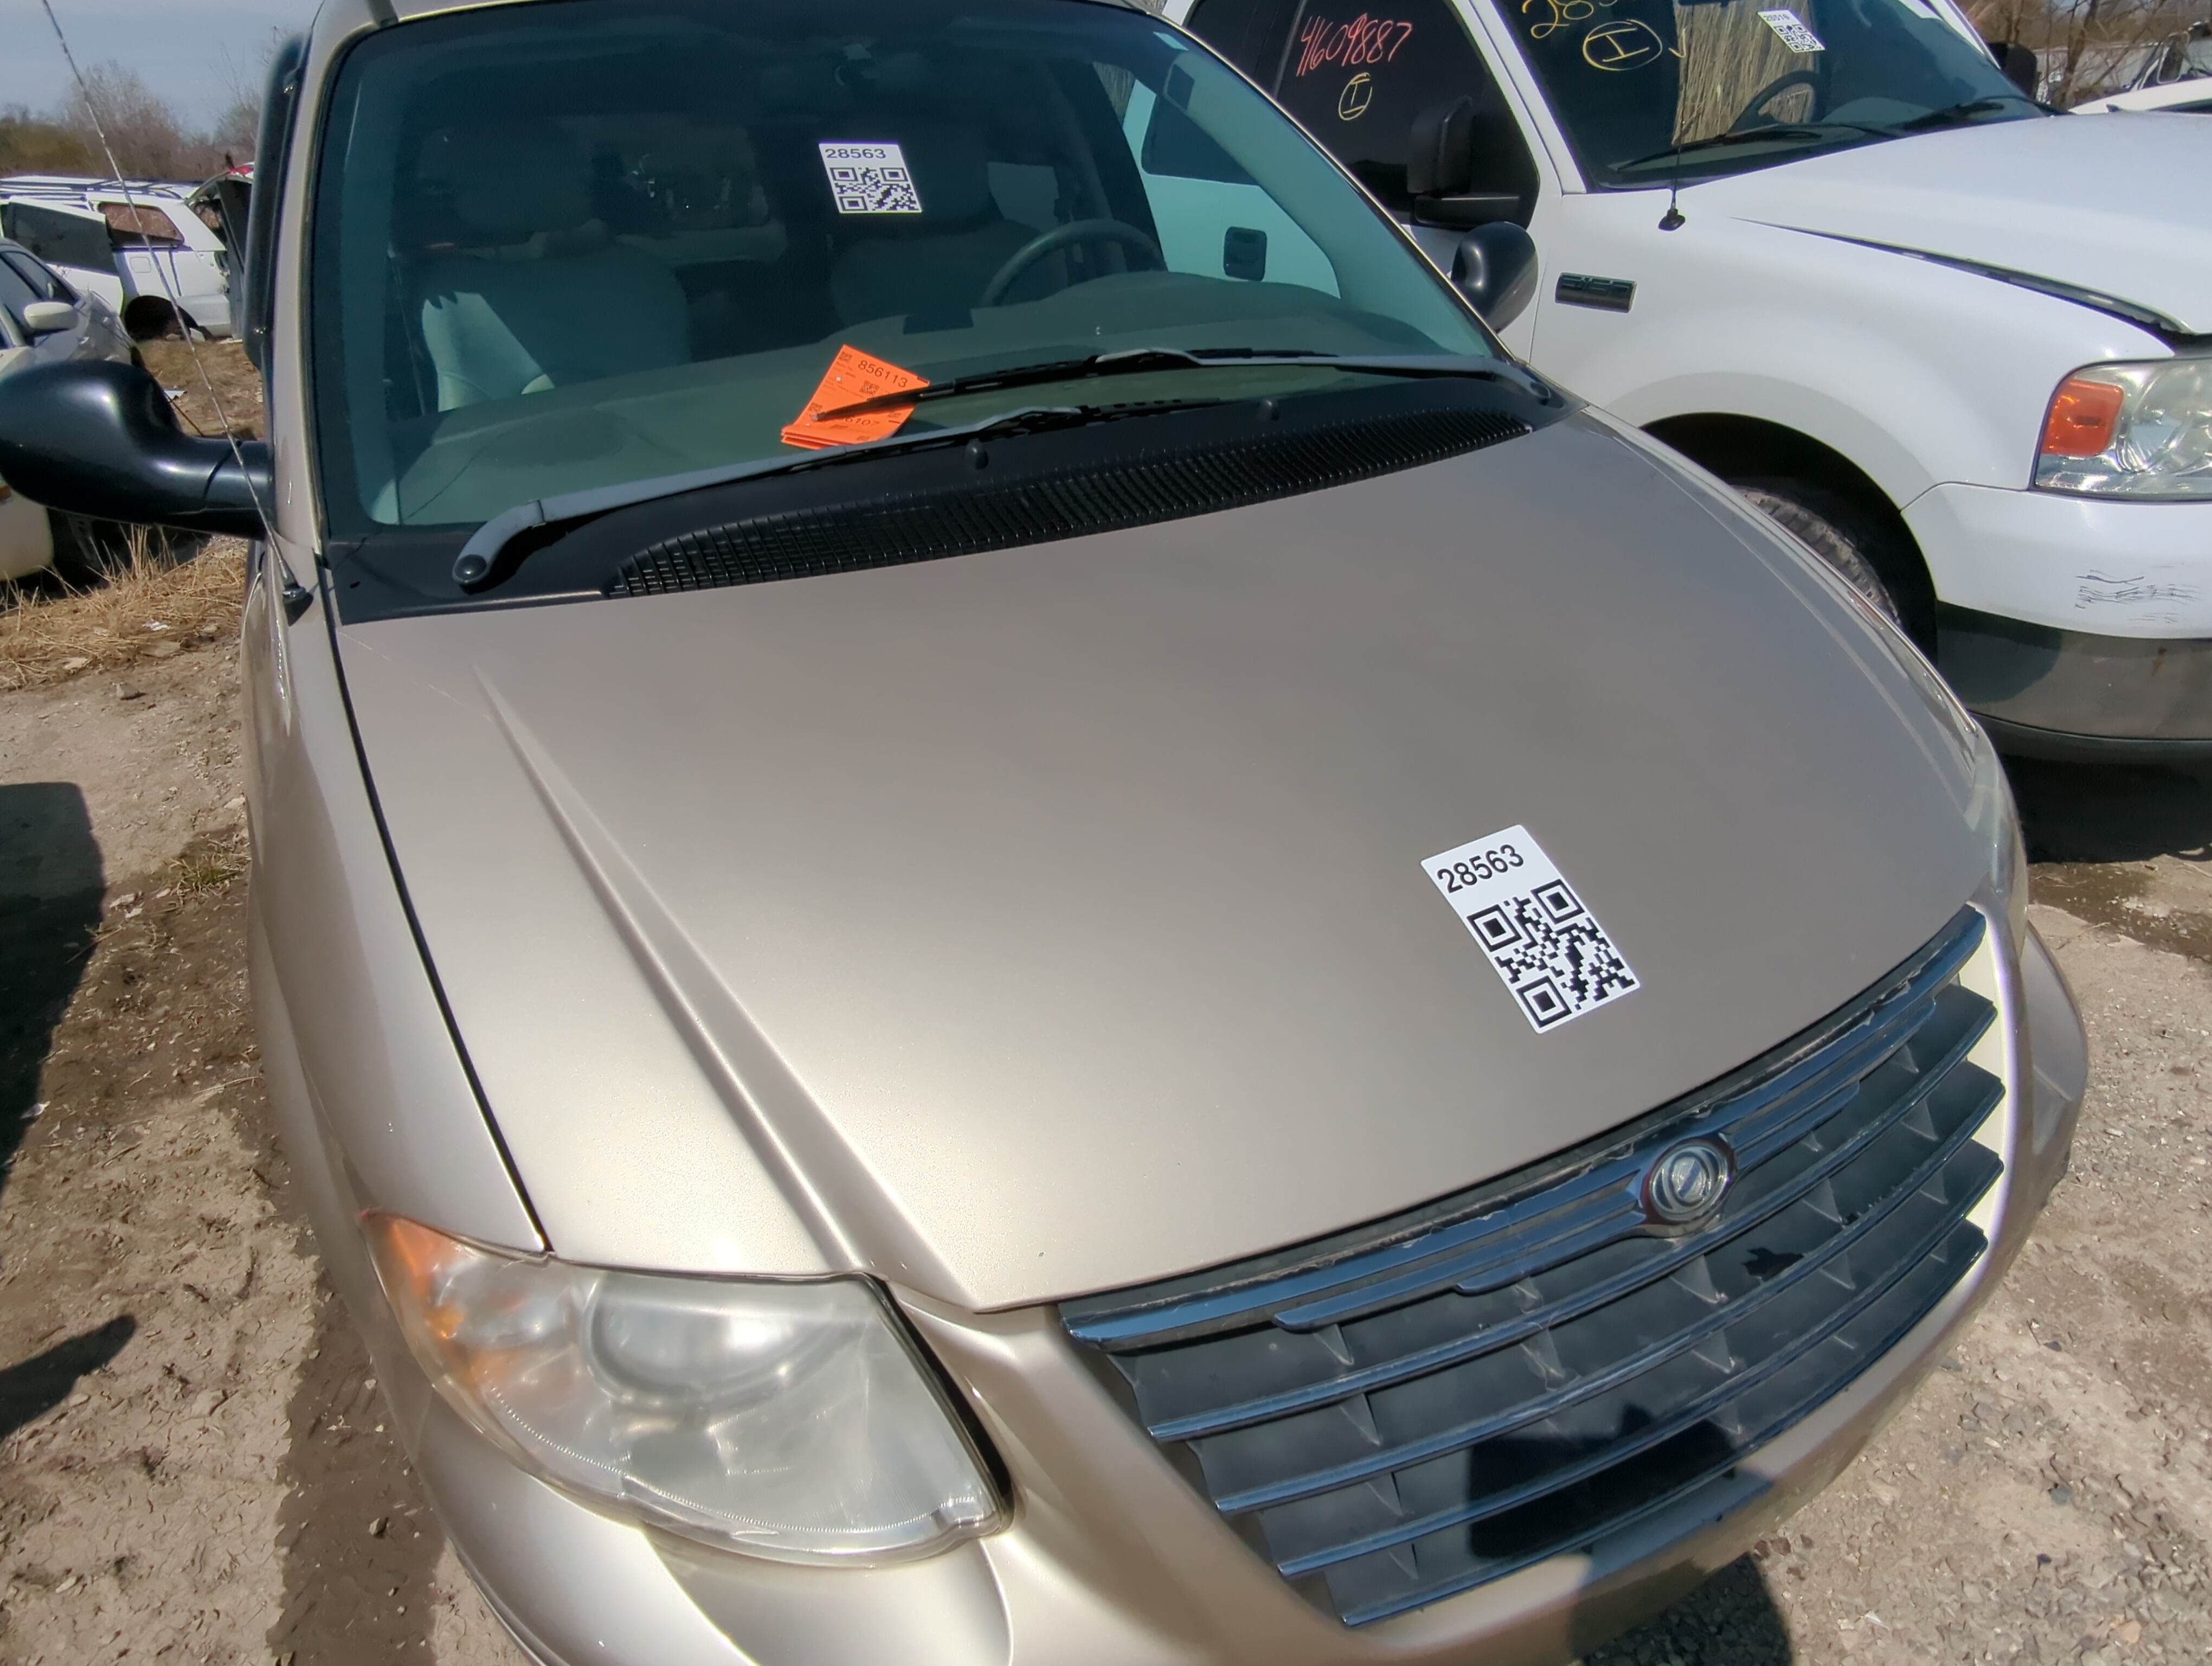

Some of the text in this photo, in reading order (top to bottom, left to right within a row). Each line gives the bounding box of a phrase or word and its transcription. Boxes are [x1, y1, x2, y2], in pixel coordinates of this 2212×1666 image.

[825, 149, 886, 158] 28563
[858, 360, 908, 388] 856113
[1437, 844, 1524, 893] 28563
